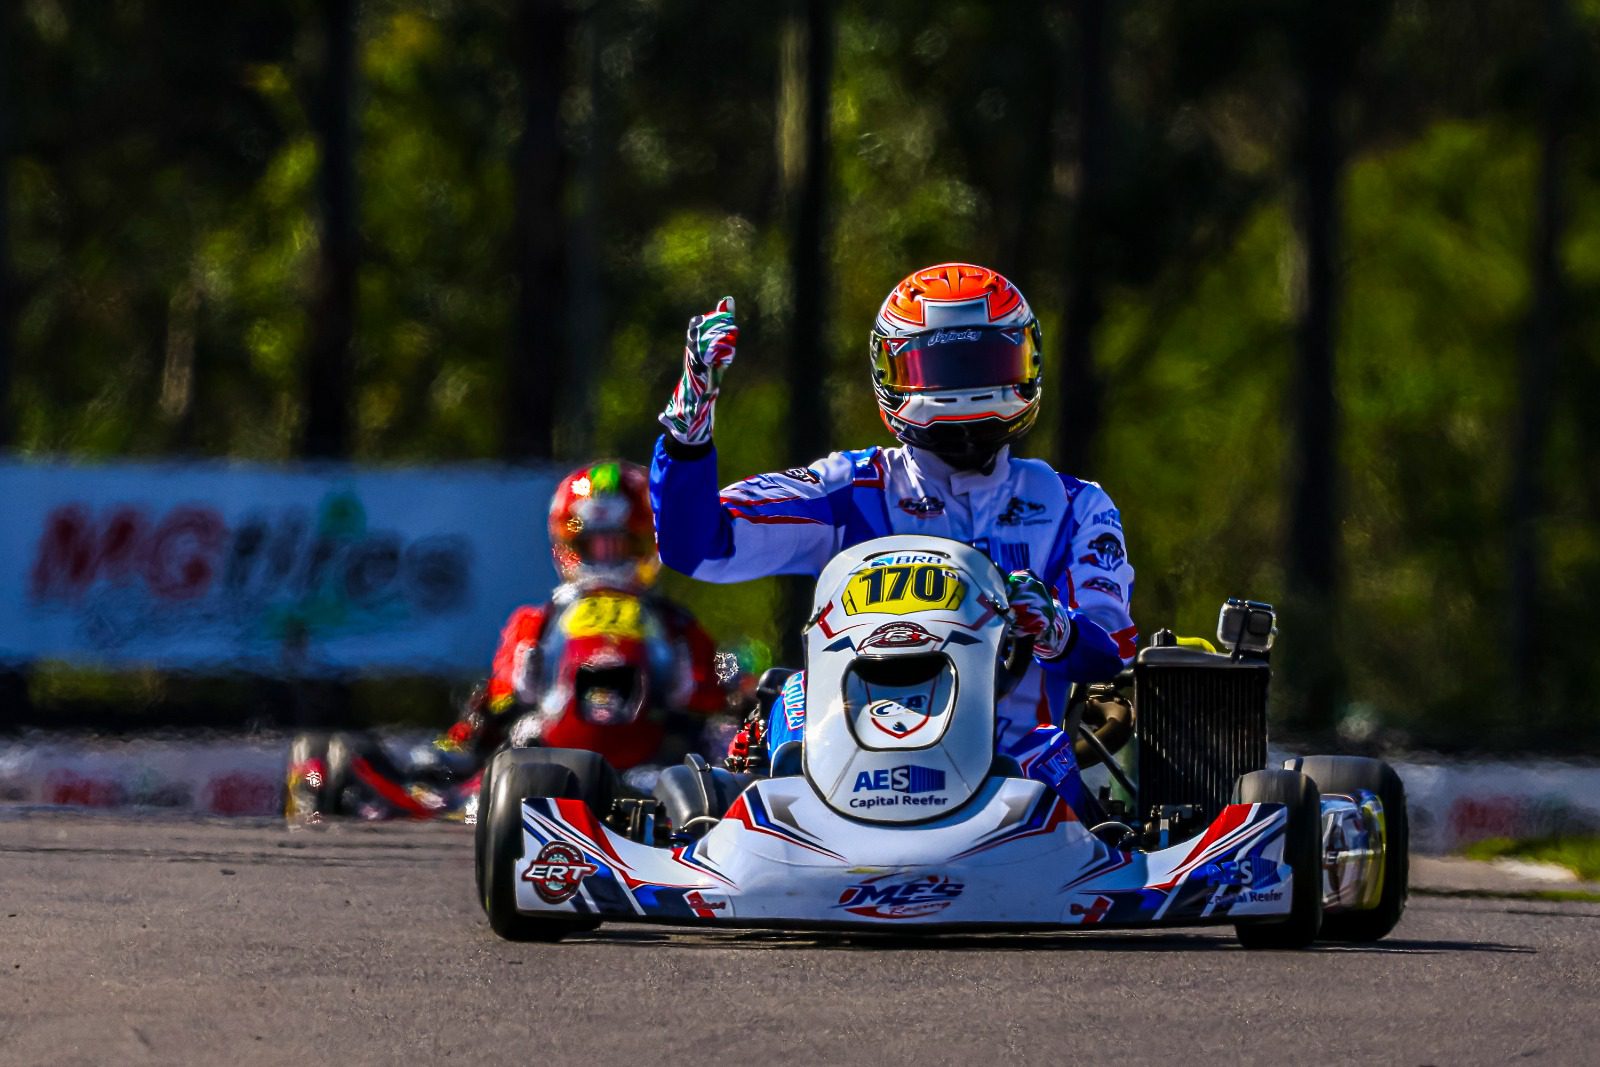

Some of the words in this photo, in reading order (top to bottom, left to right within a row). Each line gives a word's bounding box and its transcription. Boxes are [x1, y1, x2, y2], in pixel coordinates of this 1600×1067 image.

[896, 555, 942, 564] BRB
[860, 566, 947, 606] 170
[852, 768, 910, 792] AES
[849, 796, 899, 809] Capital
[902, 795, 949, 806] Reefer
[525, 865, 592, 880] ERT
[1250, 889, 1284, 902] Reefer
